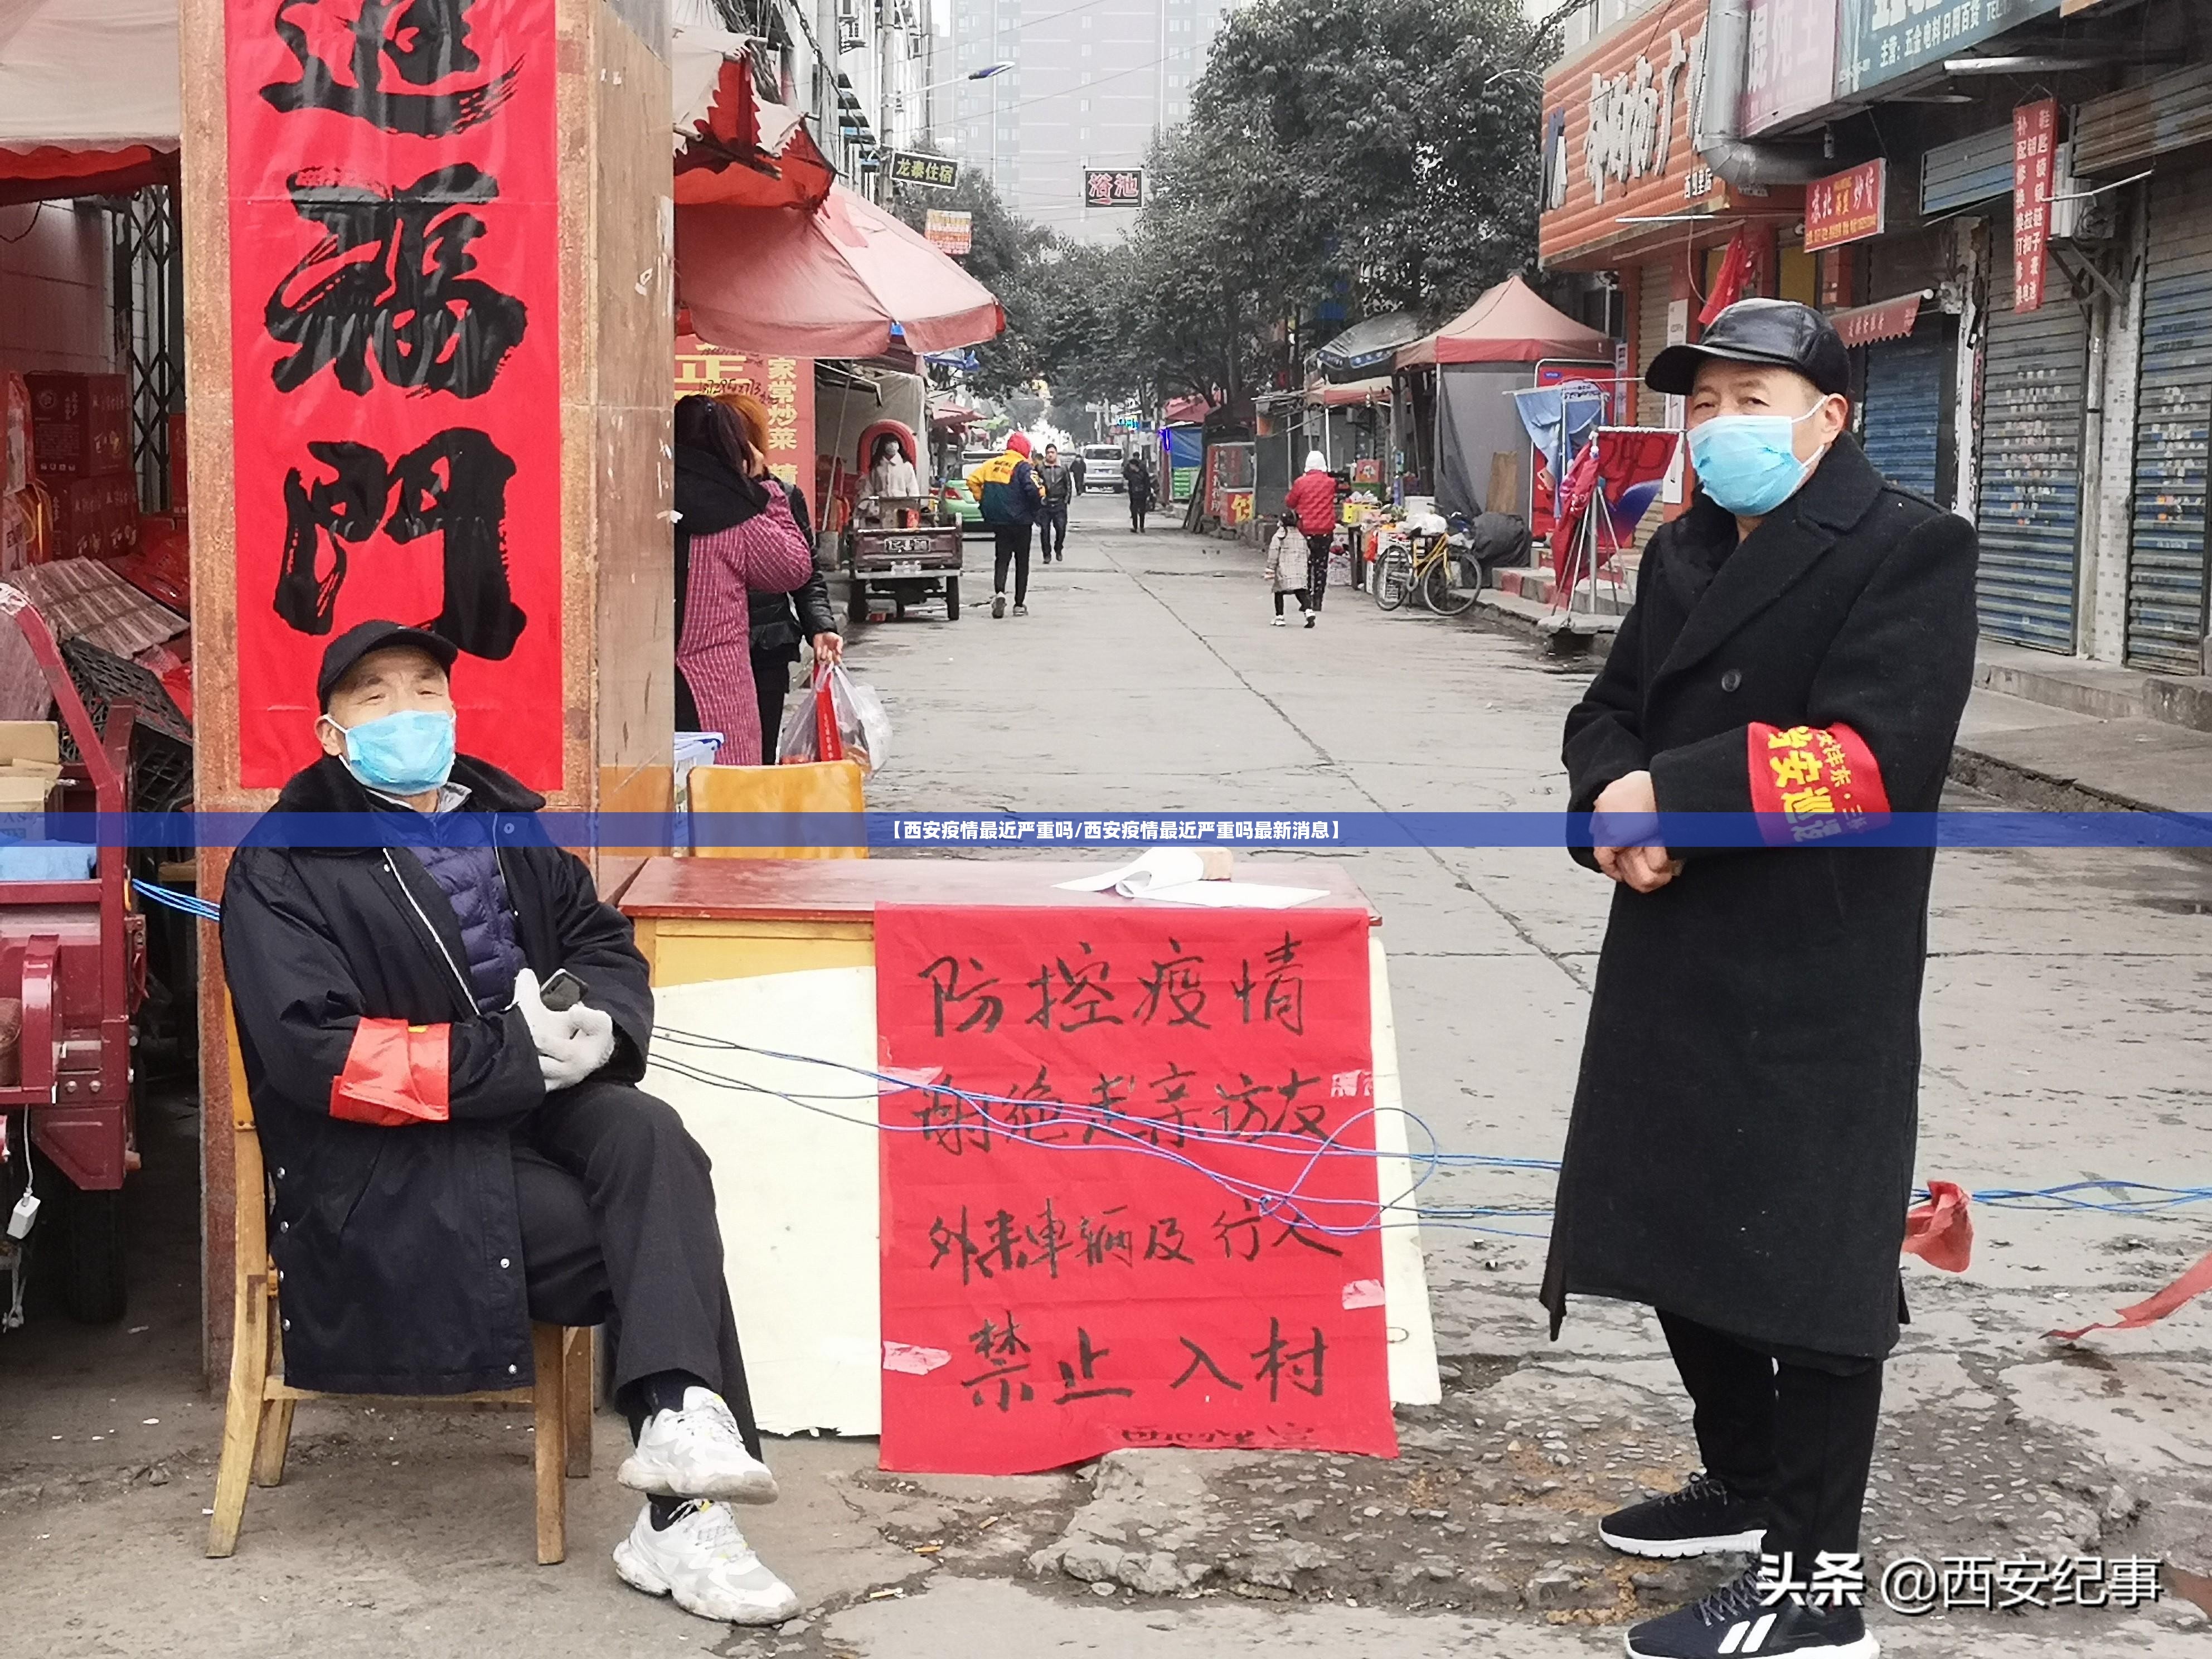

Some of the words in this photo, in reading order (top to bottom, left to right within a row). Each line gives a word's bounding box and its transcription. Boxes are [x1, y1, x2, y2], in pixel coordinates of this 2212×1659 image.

[1088, 173, 1139, 197] 浴池
[767, 357, 798, 450] 家常炒菜
[918, 930, 1305, 1038] 防控疫情
[961, 1310, 1330, 1412] 禁止入村
